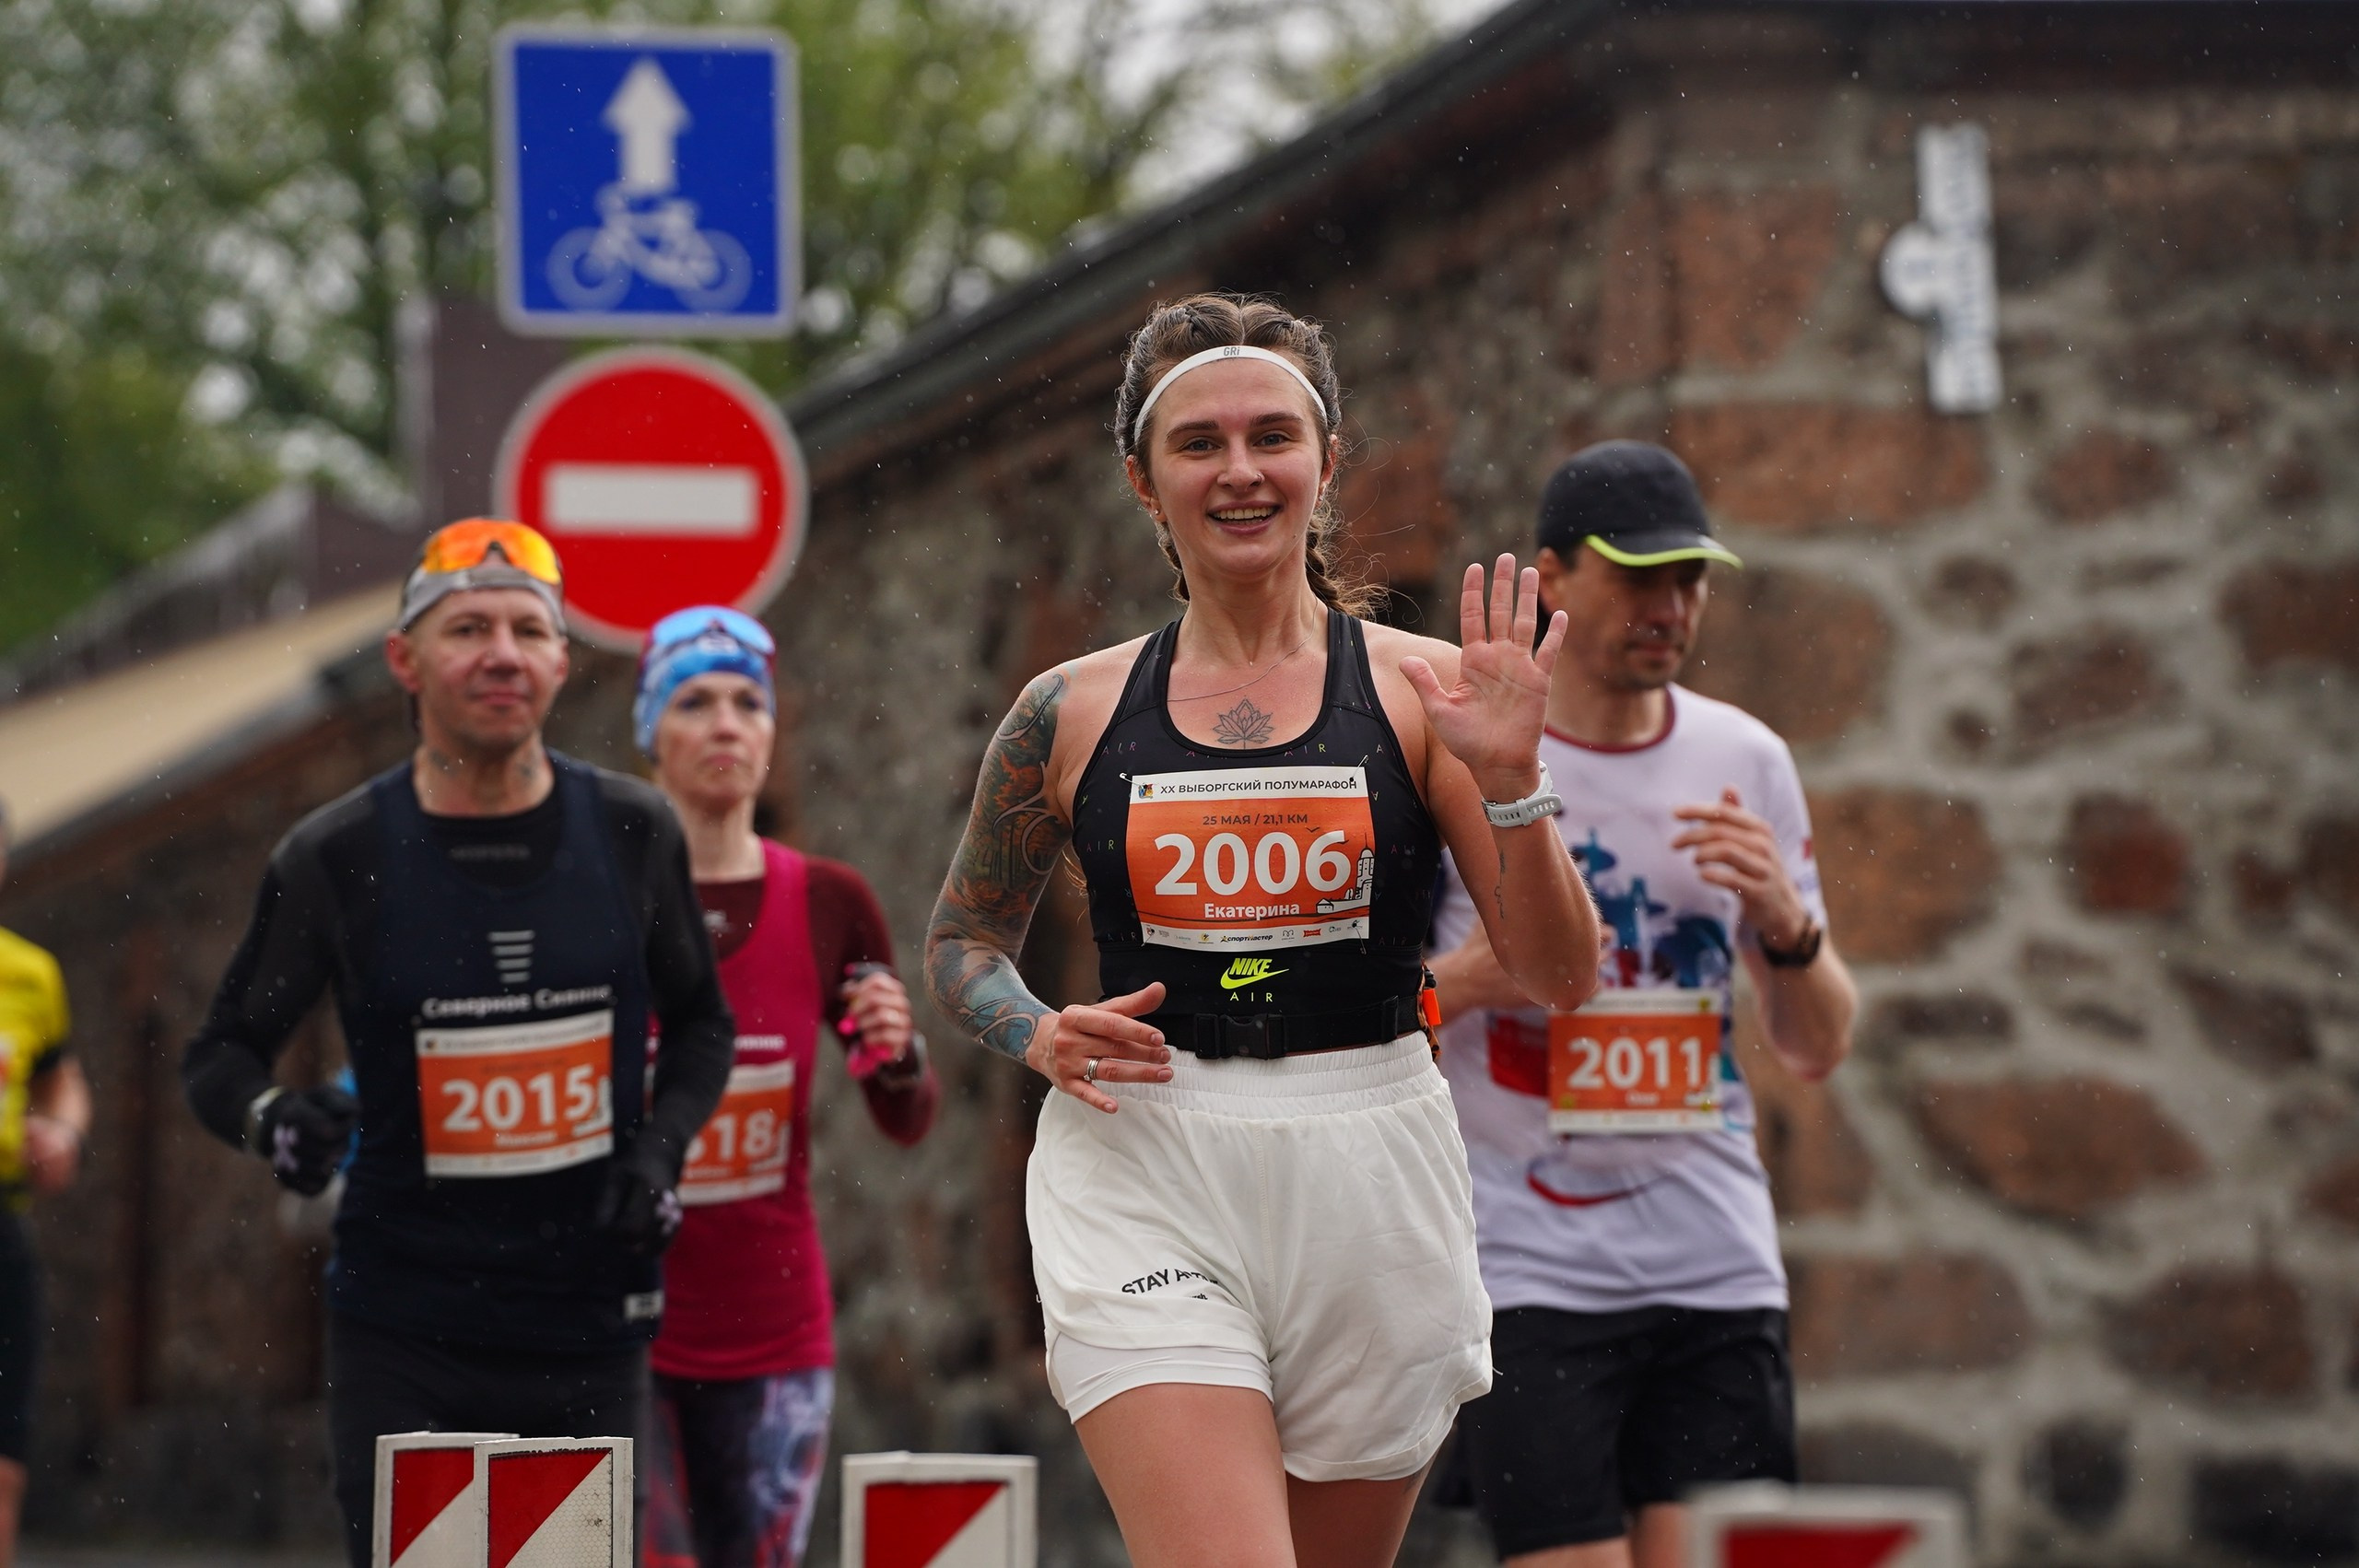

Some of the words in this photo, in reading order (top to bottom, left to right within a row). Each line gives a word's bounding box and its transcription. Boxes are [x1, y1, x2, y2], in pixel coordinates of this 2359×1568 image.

[1179, 779, 1261, 793] ВЫБОРГСКИЙ
[1264, 779, 1357, 790] ПОЛУМАРАФОН
[1203, 815, 1217, 825] 25
[1221, 815, 1250, 825] МАЯ
[1254, 813, 1261, 825] /
[1262, 814, 1284, 825] 21,1
[1287, 814, 1308, 824] КМ
[1154, 830, 1351, 895] 2006
[1203, 903, 1300, 920] Екатерина
[1228, 957, 1273, 976] NIKE
[1229, 991, 1273, 1002] AIR
[1568, 1036, 1701, 1089] 2011
[441, 1064, 595, 1132] 2015
[1121, 1269, 1170, 1294] STAY
